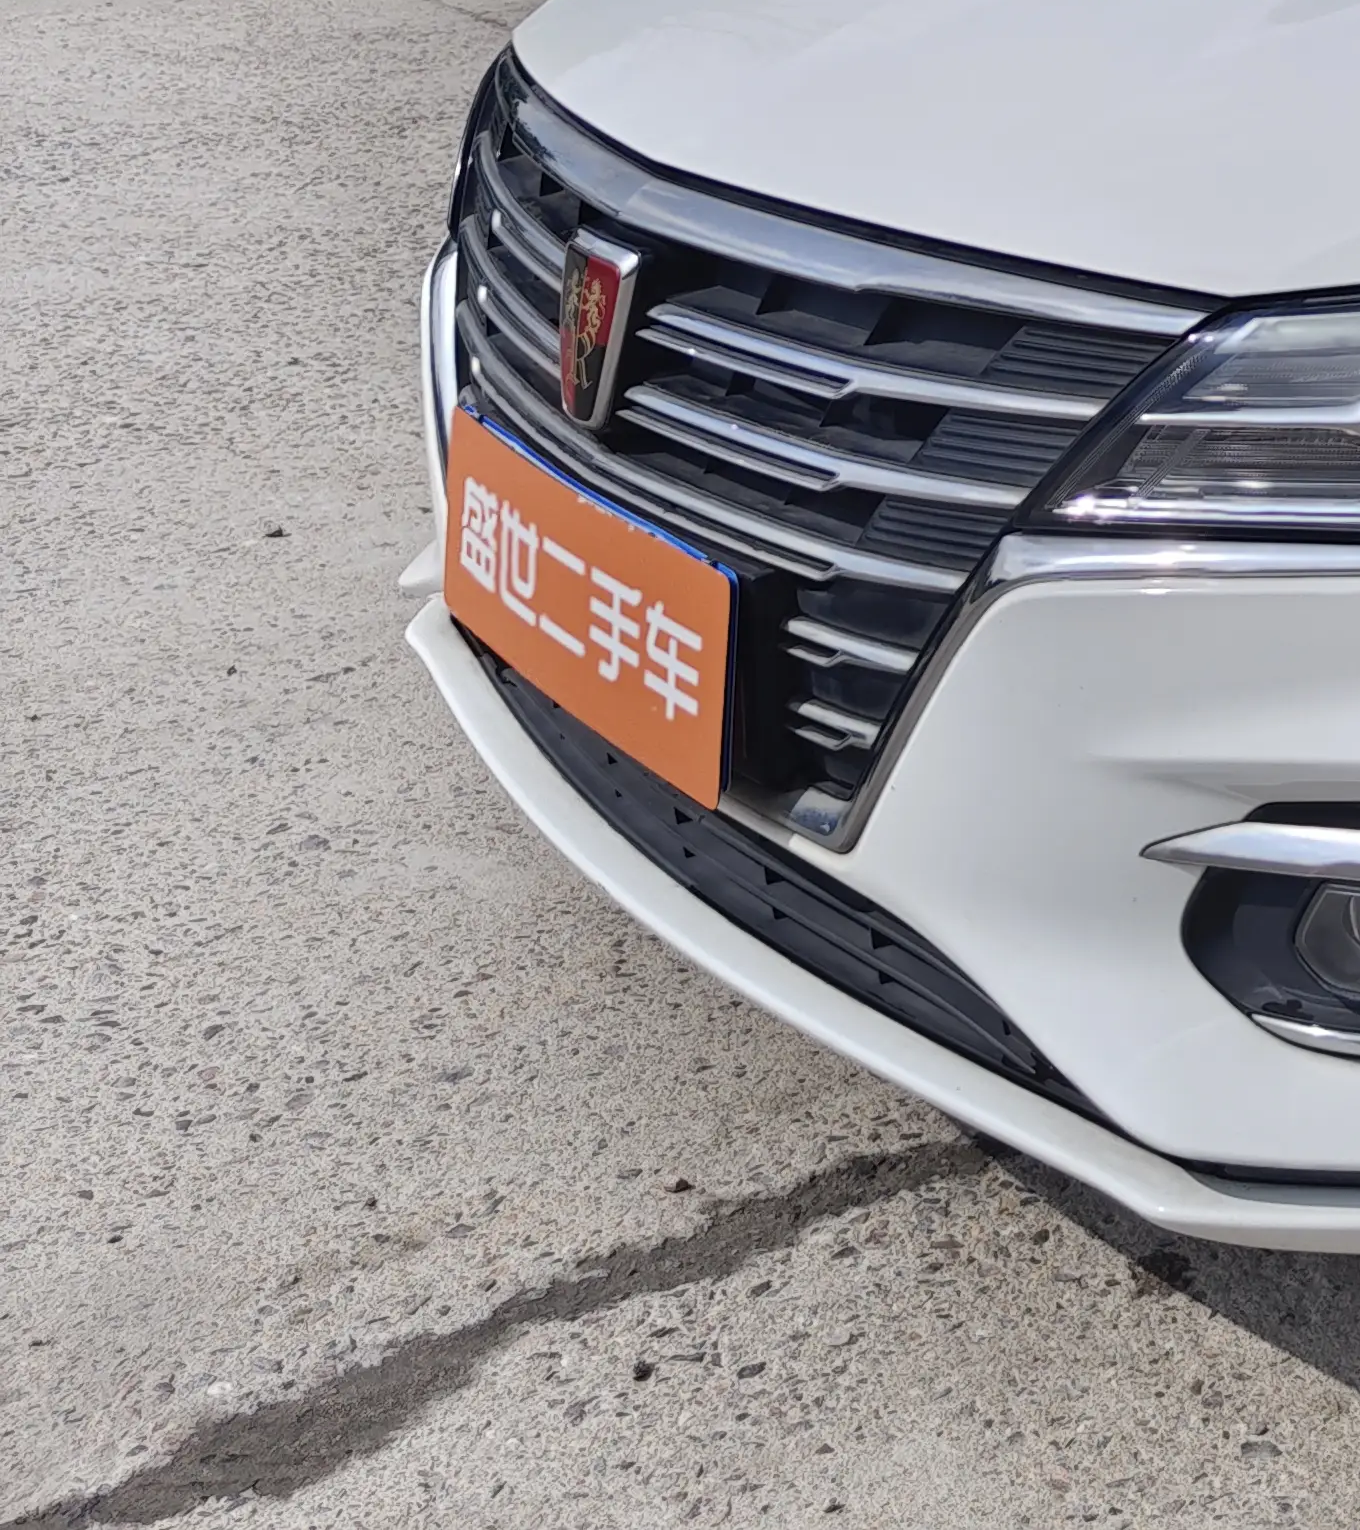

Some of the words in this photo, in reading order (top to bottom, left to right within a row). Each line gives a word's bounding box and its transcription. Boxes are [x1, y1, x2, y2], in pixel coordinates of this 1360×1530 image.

[460, 476, 703, 721] 盛世二手车
